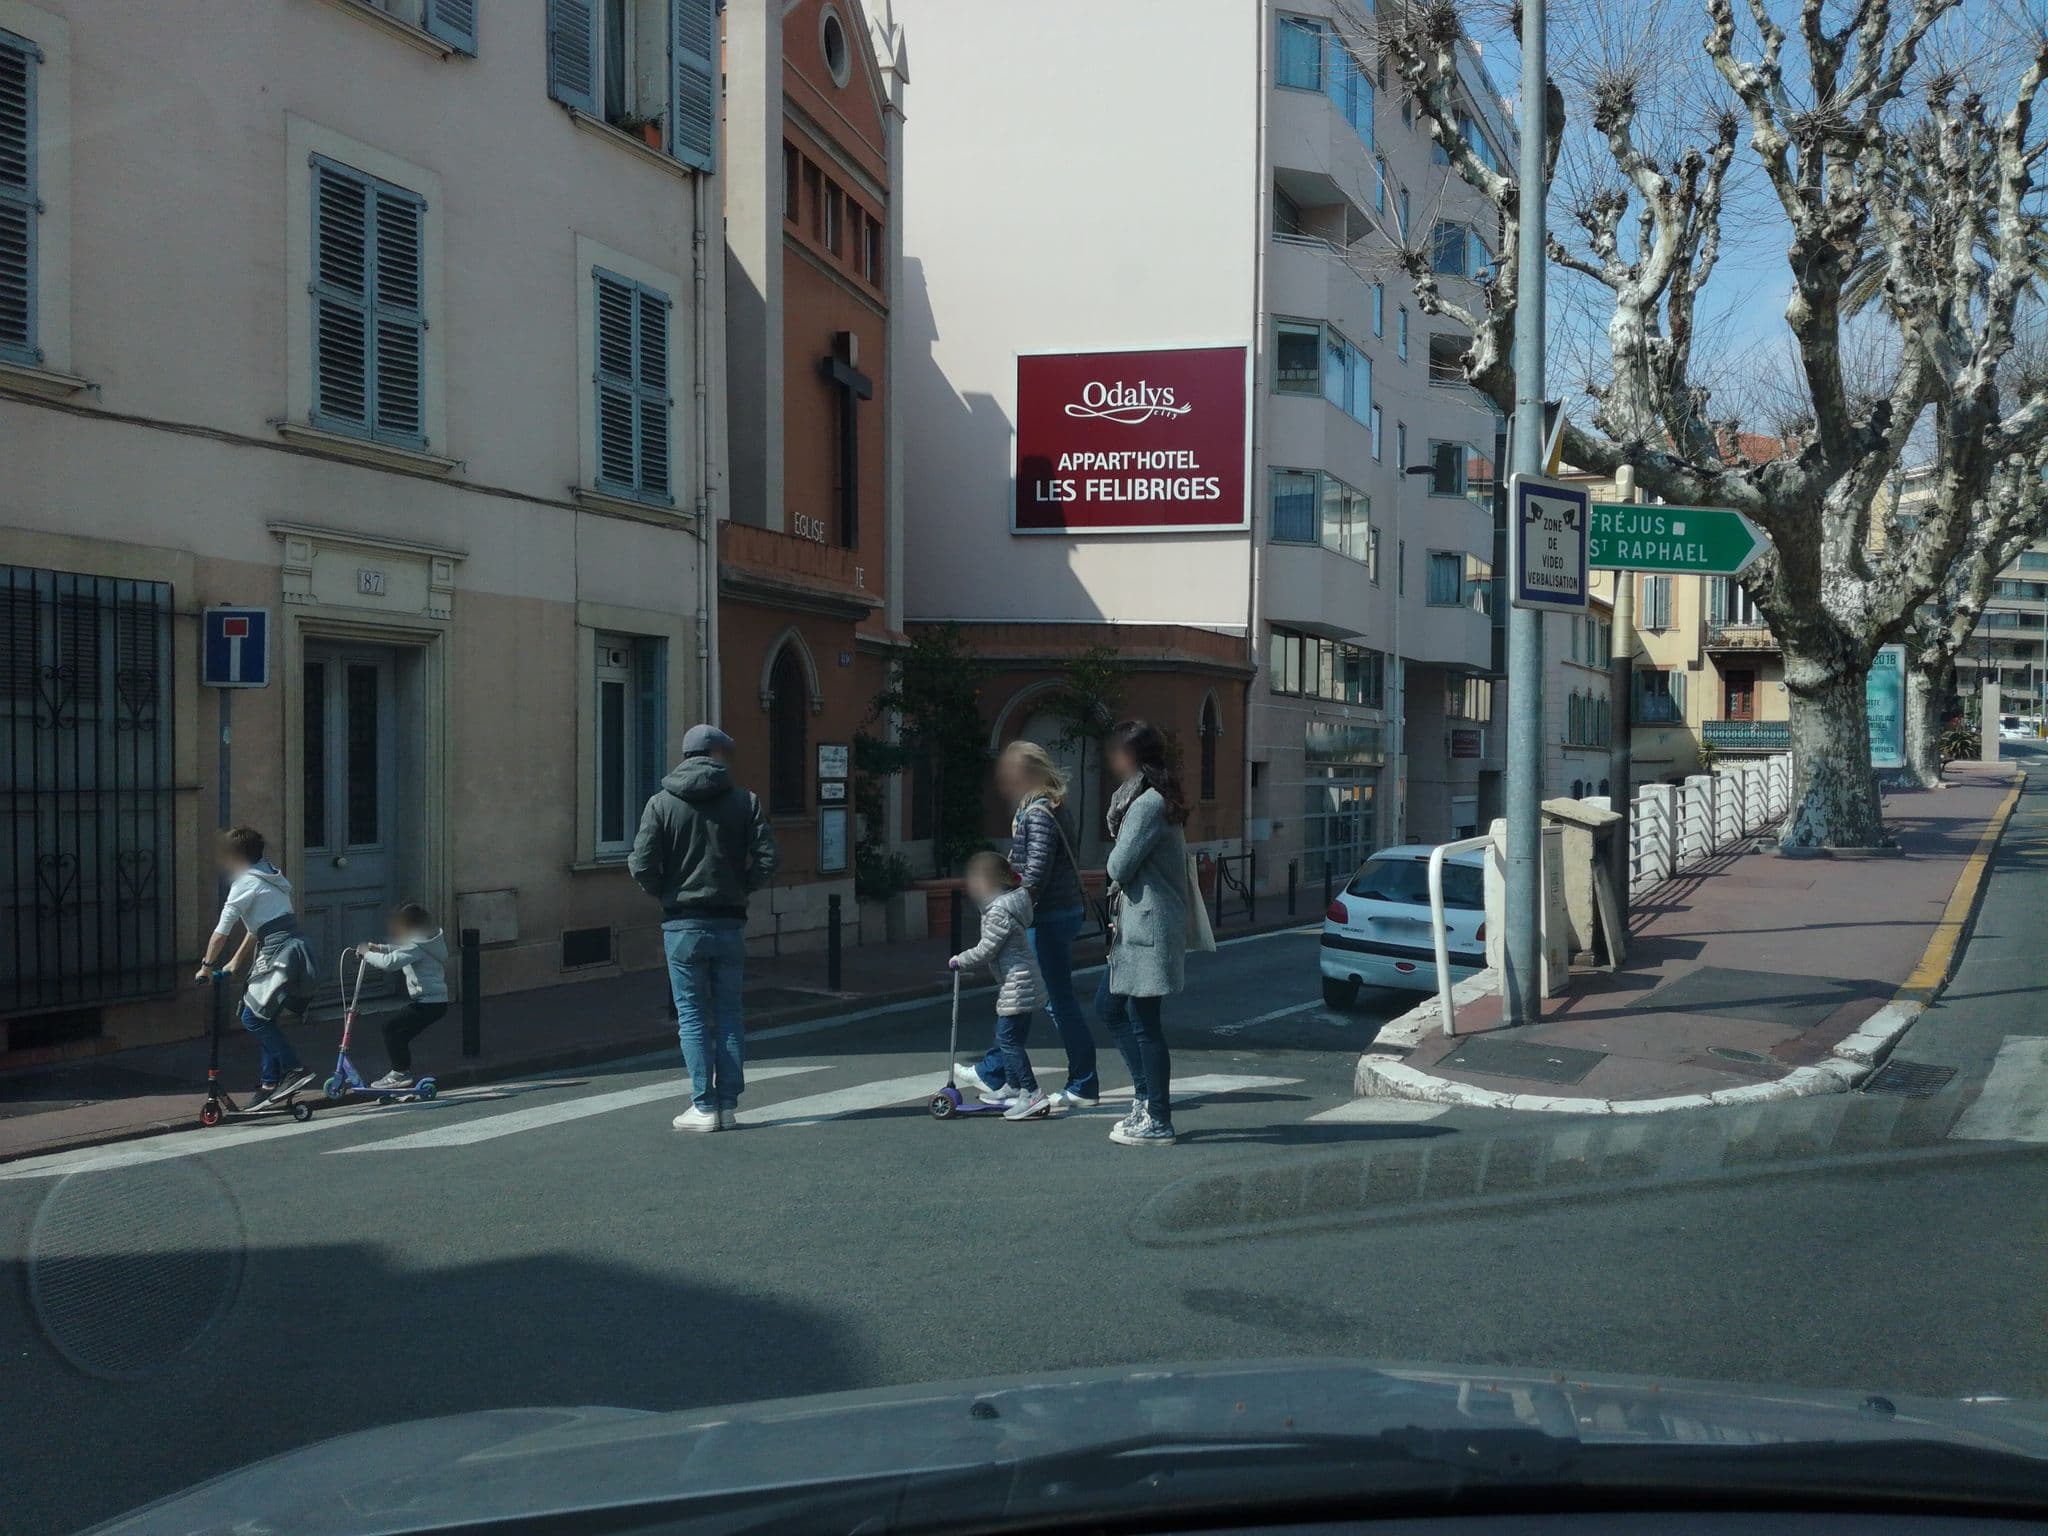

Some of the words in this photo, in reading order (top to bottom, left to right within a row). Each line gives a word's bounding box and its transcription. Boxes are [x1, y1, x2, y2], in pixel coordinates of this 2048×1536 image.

[1083, 380, 1175, 408] Odalys
[1057, 451, 1200, 471] APPART'HOTEL
[1036, 479, 1077, 502] LES
[1086, 477, 1221, 501] FELIBRIGES
[794, 511, 825, 543] EGLISE
[1543, 518, 1563, 533] ZONE
[1590, 511, 1665, 535] FRÉJUS
[1548, 537, 1558, 550] DE
[1618, 540, 1708, 562] RAPHAEL
[1542, 554, 1564, 569] VIDEO
[365, 573, 380, 591] 87
[1527, 570, 1578, 589] VERBALISATION
[1873, 654, 1897, 665] 2018
